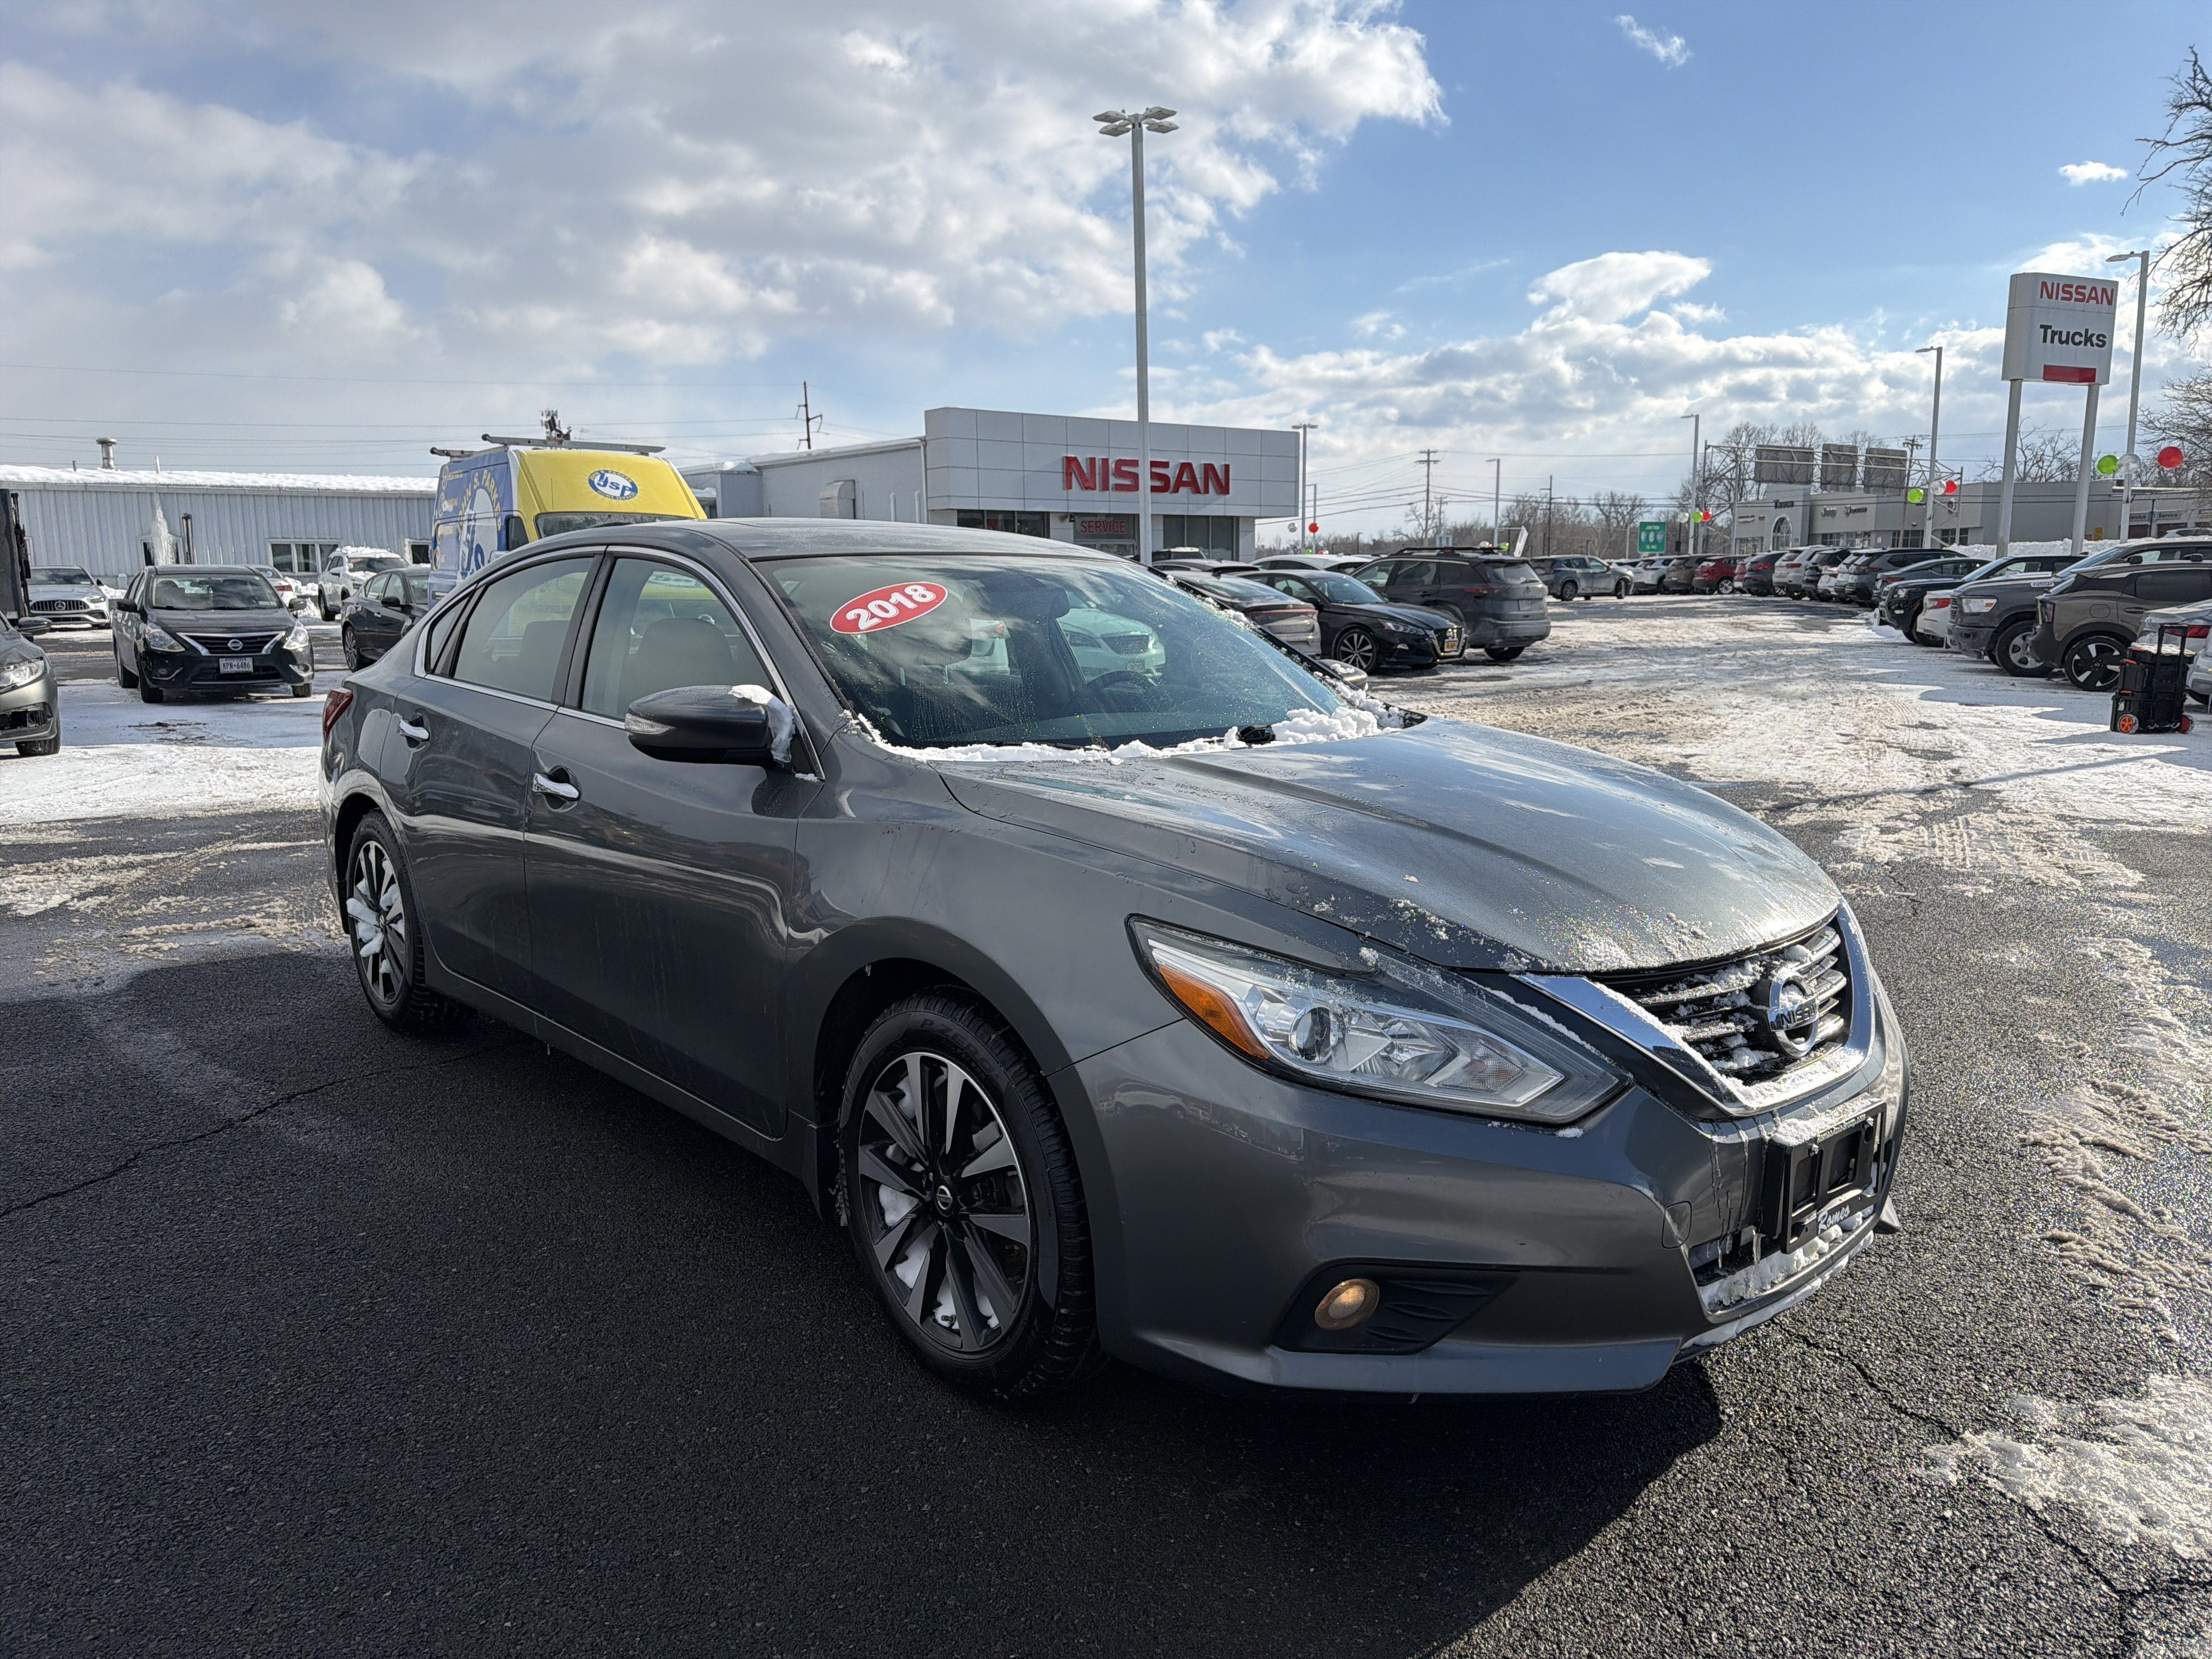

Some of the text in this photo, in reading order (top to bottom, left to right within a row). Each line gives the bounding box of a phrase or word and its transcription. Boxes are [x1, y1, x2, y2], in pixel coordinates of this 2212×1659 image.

[2040, 281, 2114, 306] NISSAN
[2039, 324, 2107, 348] Trucks
[1064, 455, 1230, 495] NISSAN
[482, 469, 501, 532] PARKER
[1081, 520, 1126, 535] SERVICE
[845, 584, 936, 630] 2018
[1818, 1204, 1850, 1235] Romeo
